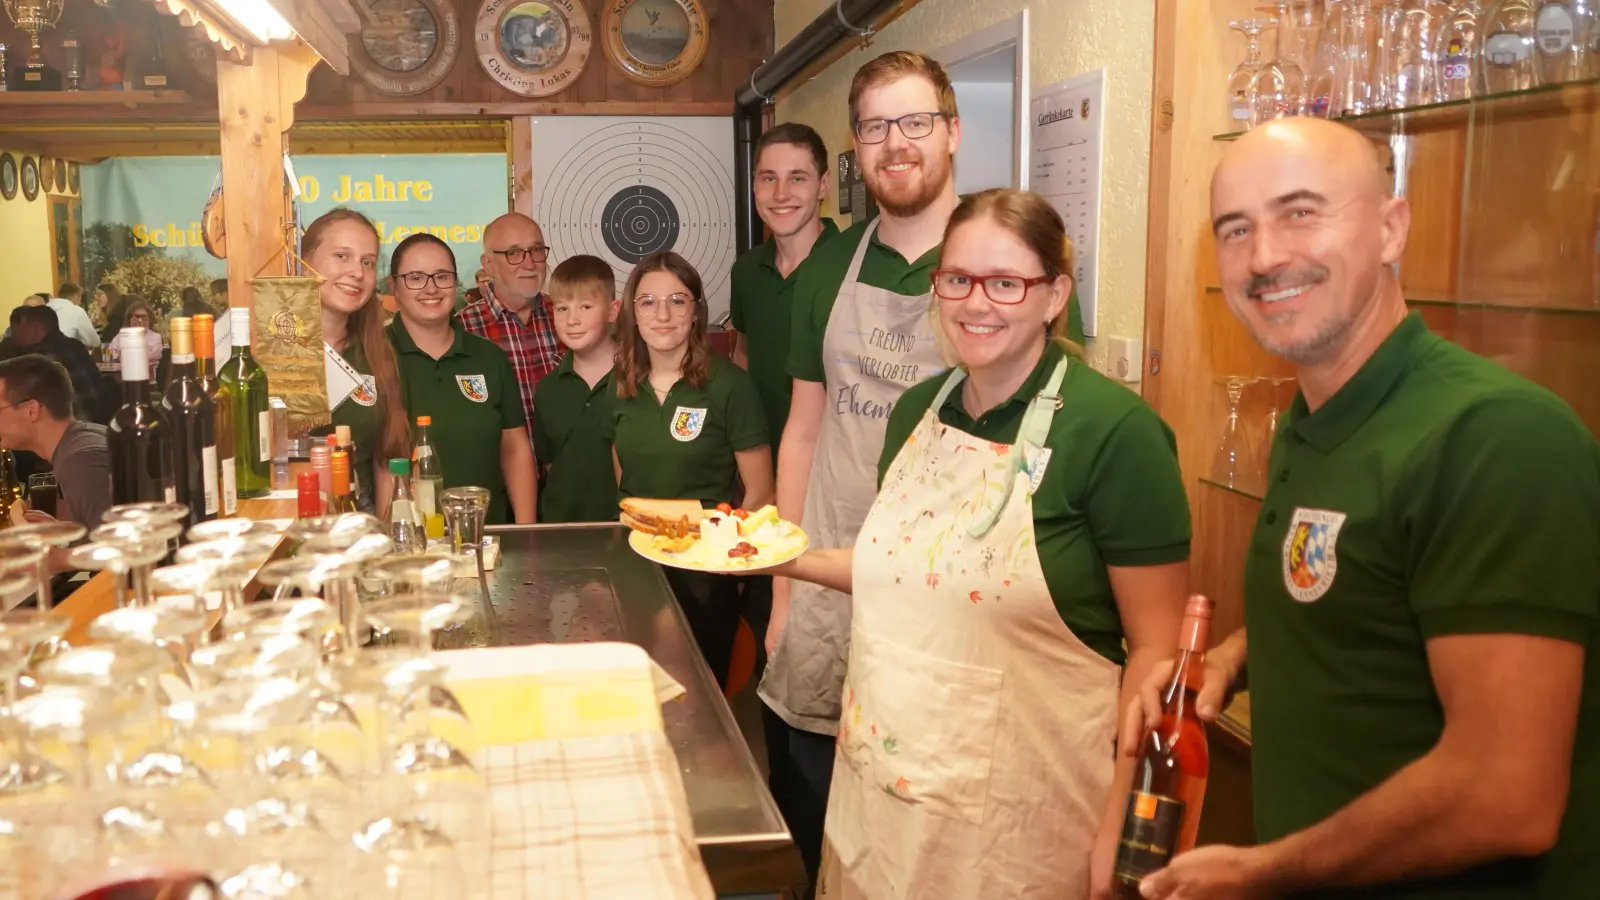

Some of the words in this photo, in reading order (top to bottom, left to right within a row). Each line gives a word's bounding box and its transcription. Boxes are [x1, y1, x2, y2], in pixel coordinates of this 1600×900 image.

[480, 32, 489, 41] 19
[540, 69, 571, 88] Lukas
[331, 174, 433, 202] Jahre
[132, 221, 205, 248] Schü
[869, 327, 916, 353] FREUND
[857, 355, 919, 382] VERLOBTER
[836, 382, 893, 420] Ehem
